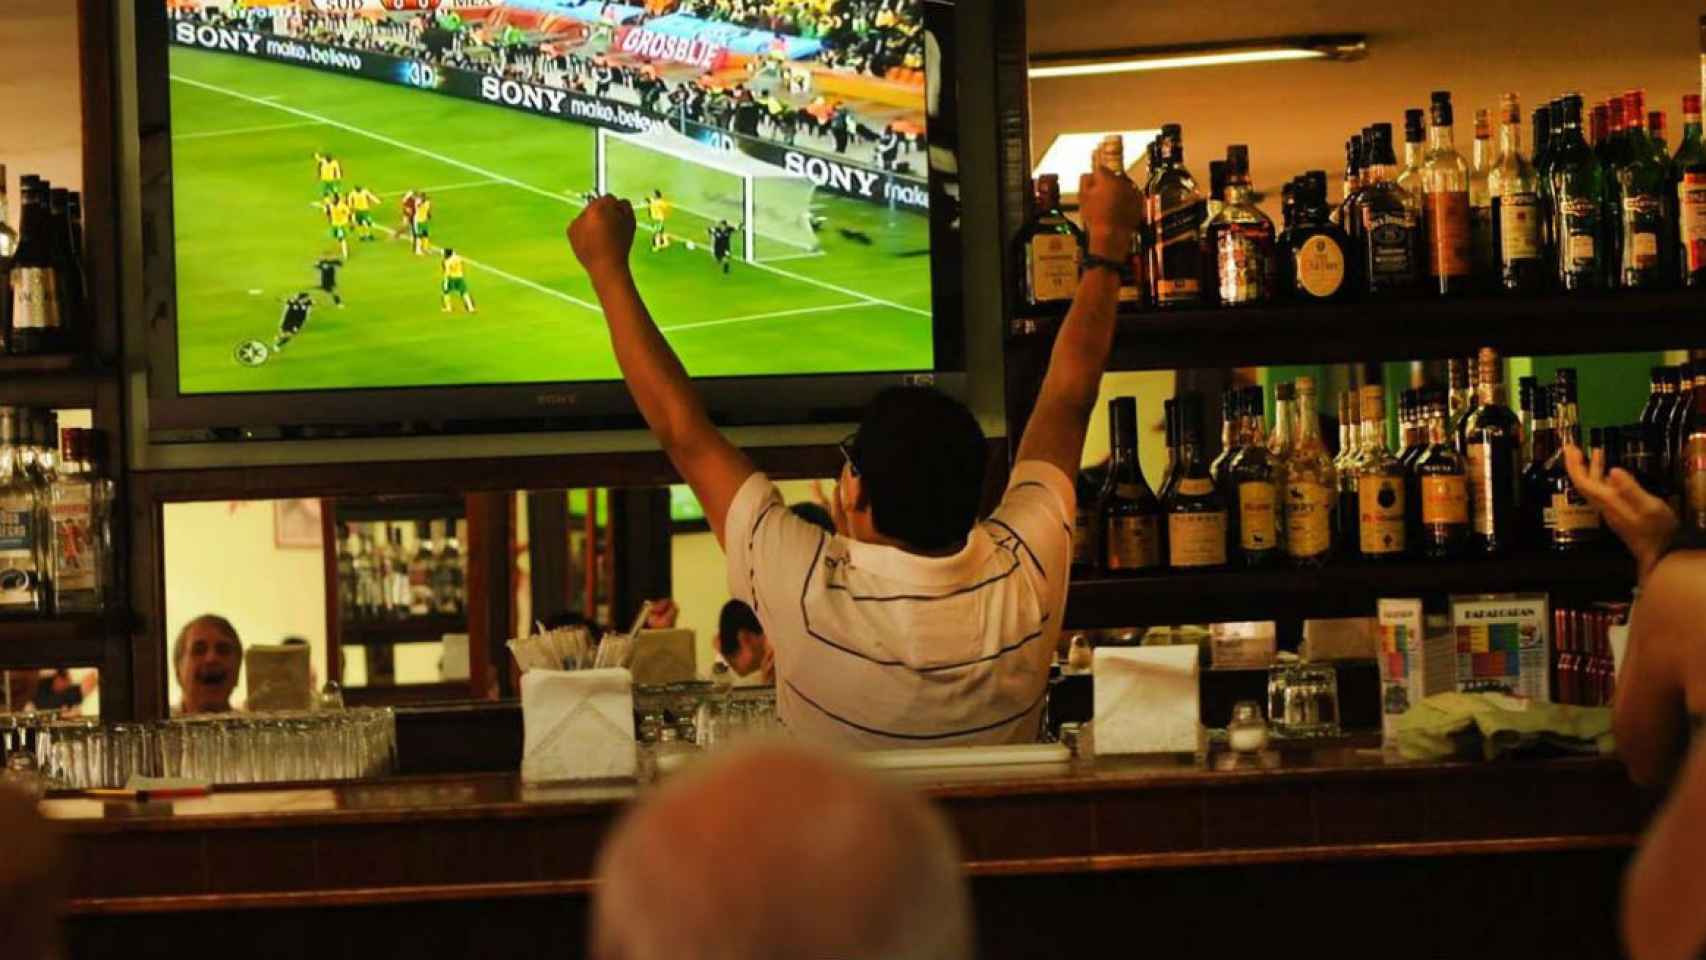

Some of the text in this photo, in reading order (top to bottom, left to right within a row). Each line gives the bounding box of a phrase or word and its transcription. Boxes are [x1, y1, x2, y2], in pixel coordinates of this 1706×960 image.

[175, 22, 261, 54] SONY
[409, 61, 435, 88] 3D
[481, 76, 566, 113] SONY
[784, 151, 878, 196] SONY
